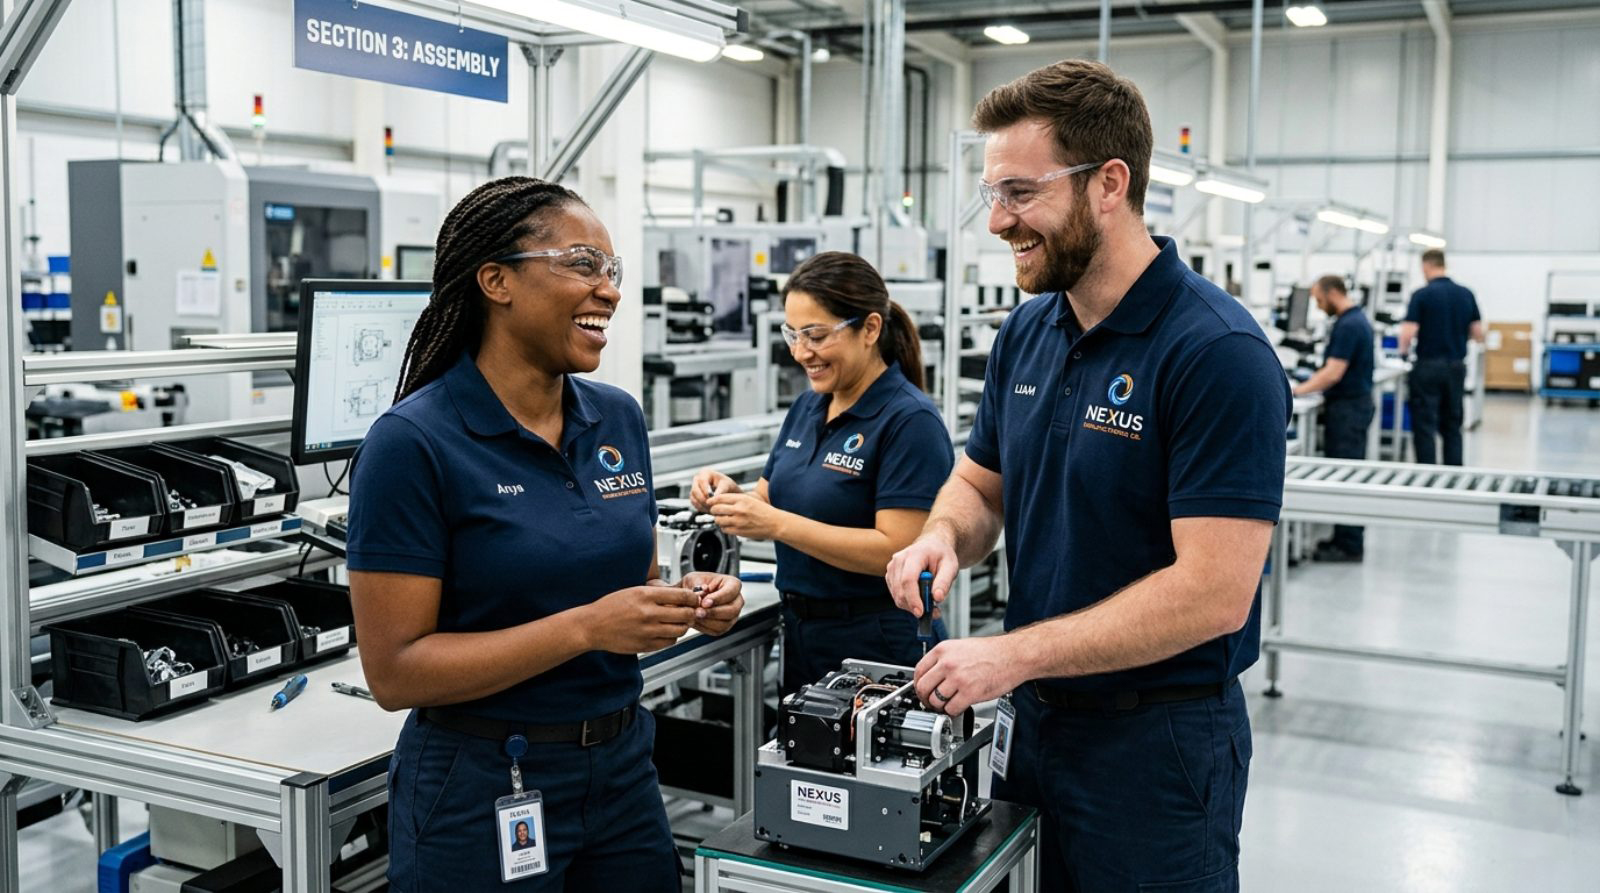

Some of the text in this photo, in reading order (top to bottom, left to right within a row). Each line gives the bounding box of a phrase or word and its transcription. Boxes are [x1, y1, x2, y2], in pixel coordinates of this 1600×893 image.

[306, 18, 500, 78] SECTION 3: ASSEMBLY
[1085, 404, 1144, 431] NEXUS
[824, 452, 865, 471] NEXUS
[497, 483, 525, 496] Anya
[594, 471, 646, 493] NEXUS
[797, 786, 842, 804] NEXUS
